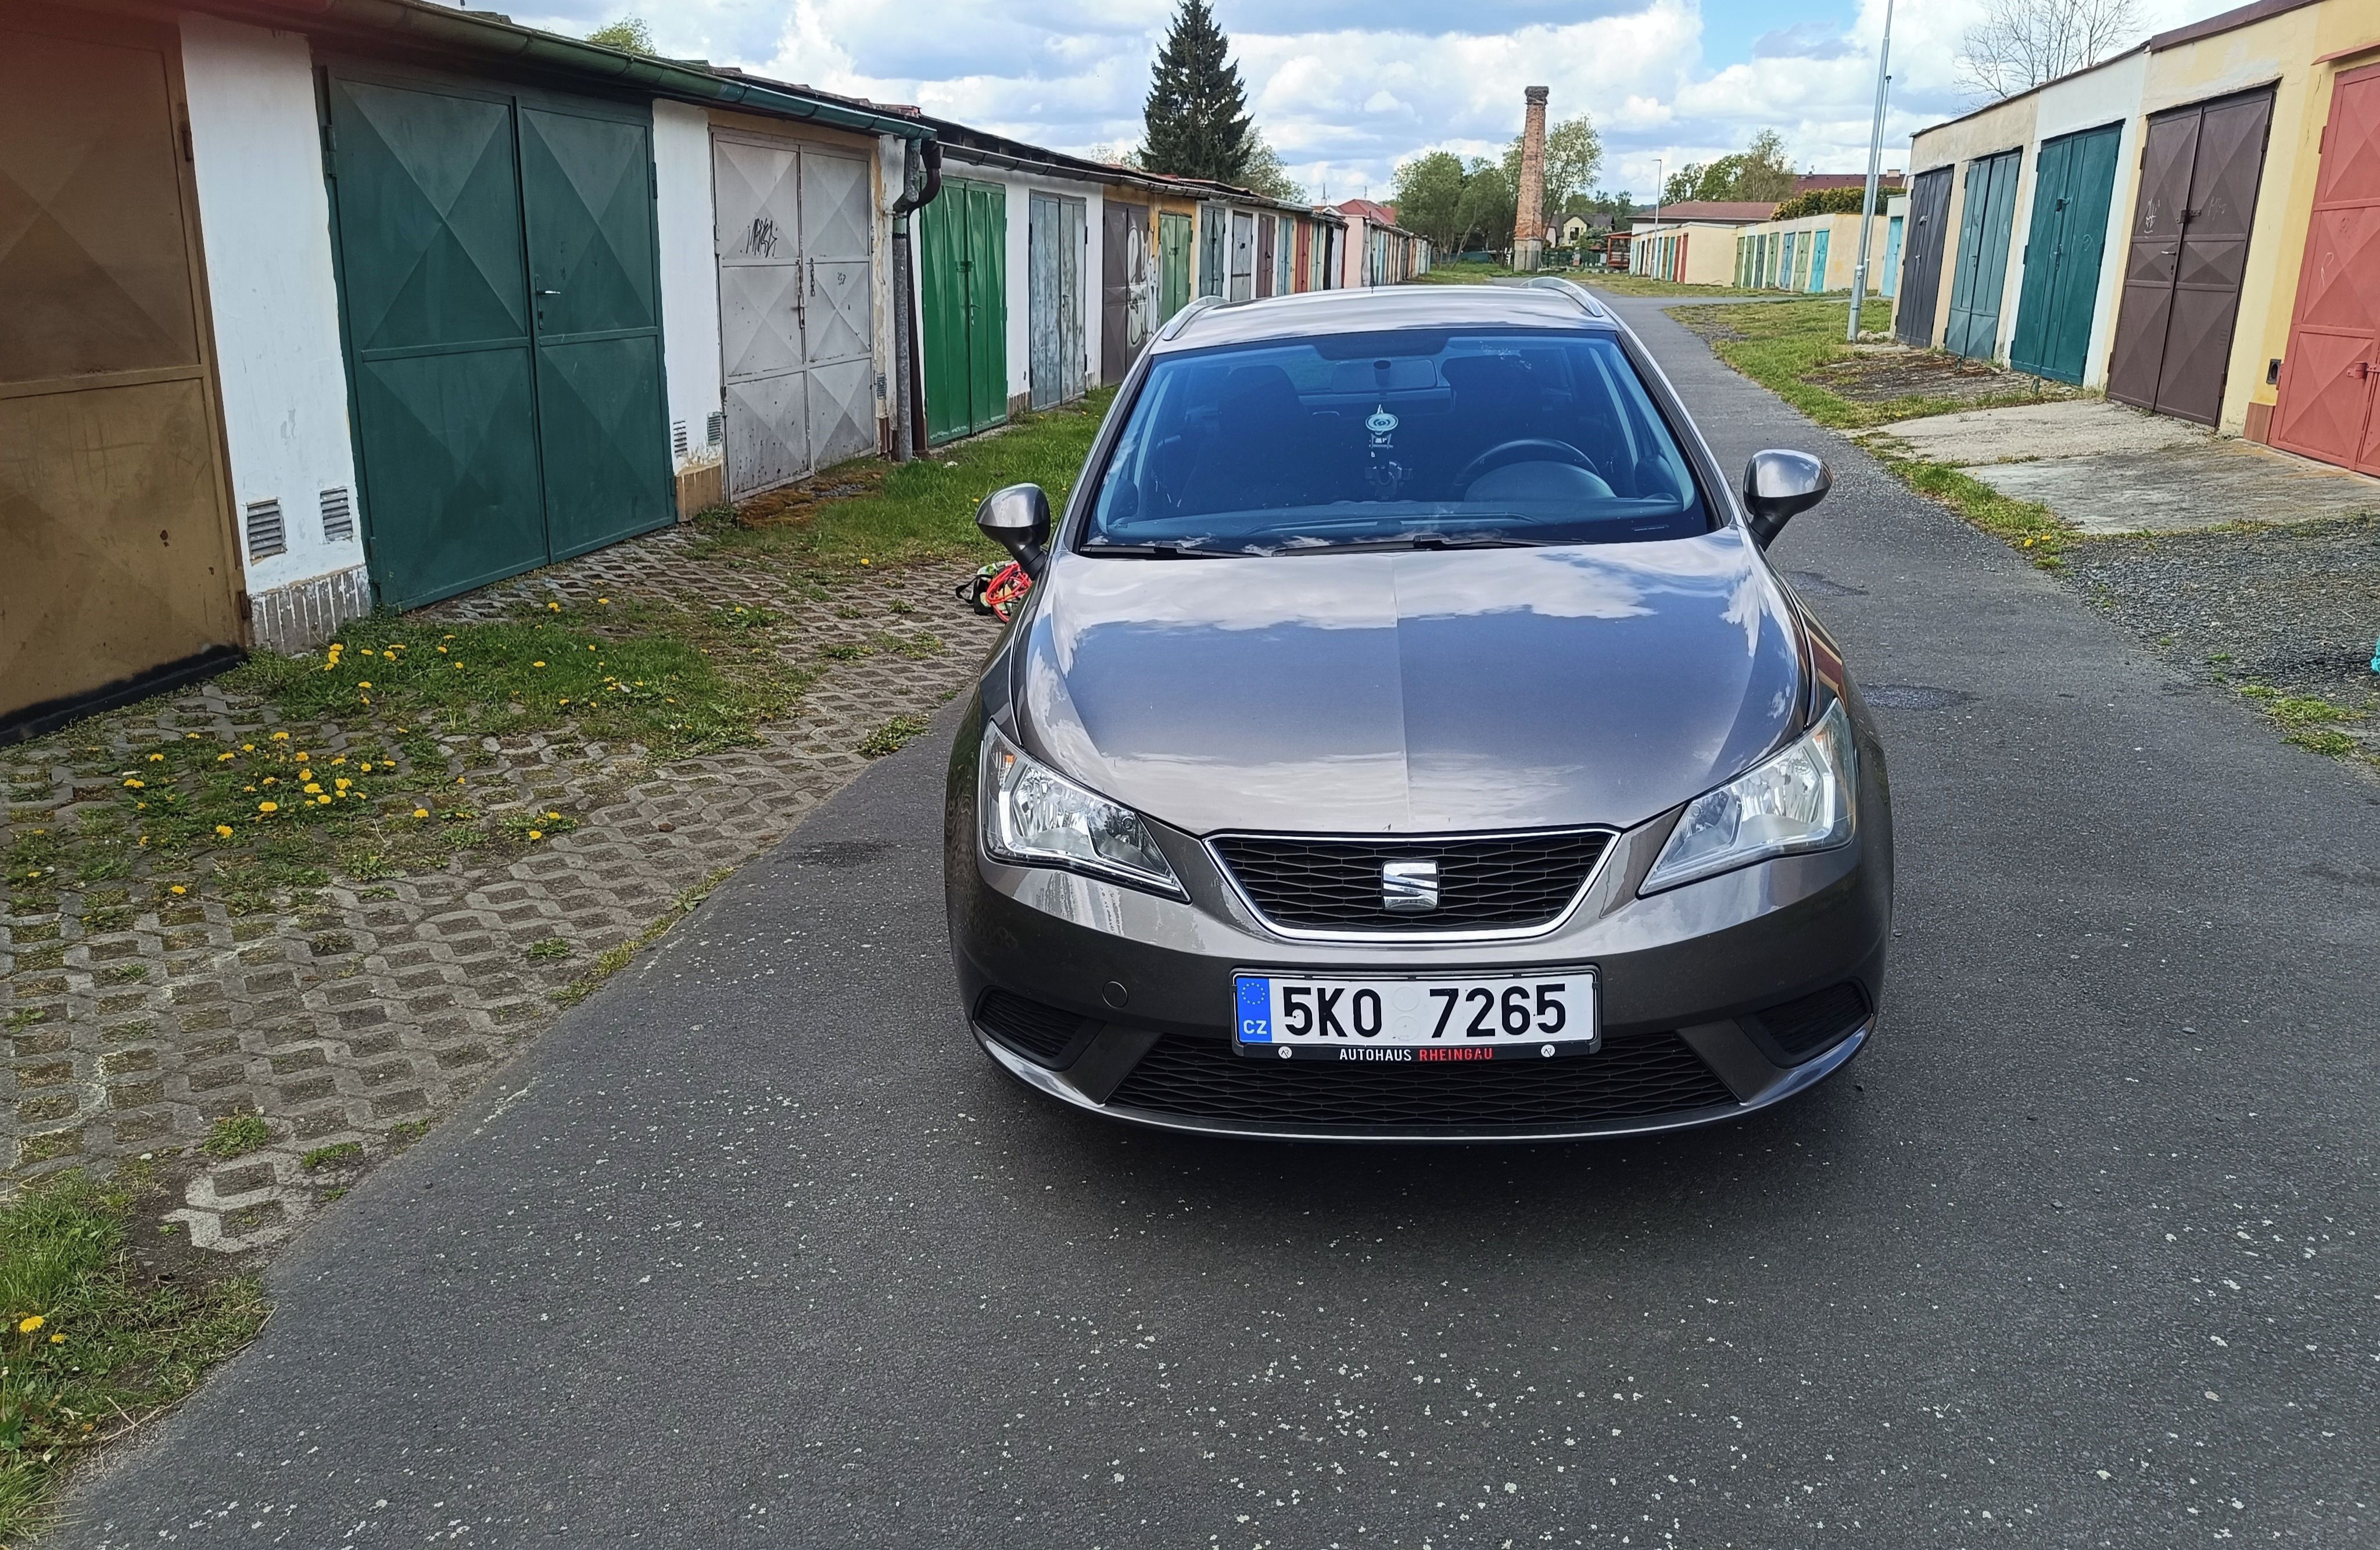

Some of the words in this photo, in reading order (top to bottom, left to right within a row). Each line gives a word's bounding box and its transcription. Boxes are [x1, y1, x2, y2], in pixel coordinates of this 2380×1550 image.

[1429, 983, 1566, 1038] 7265
[1243, 1020, 1267, 1035] CZ
[1339, 1048, 1412, 1061] AUTOHAUS
[1419, 1047, 1493, 1061] RHEINGAU
